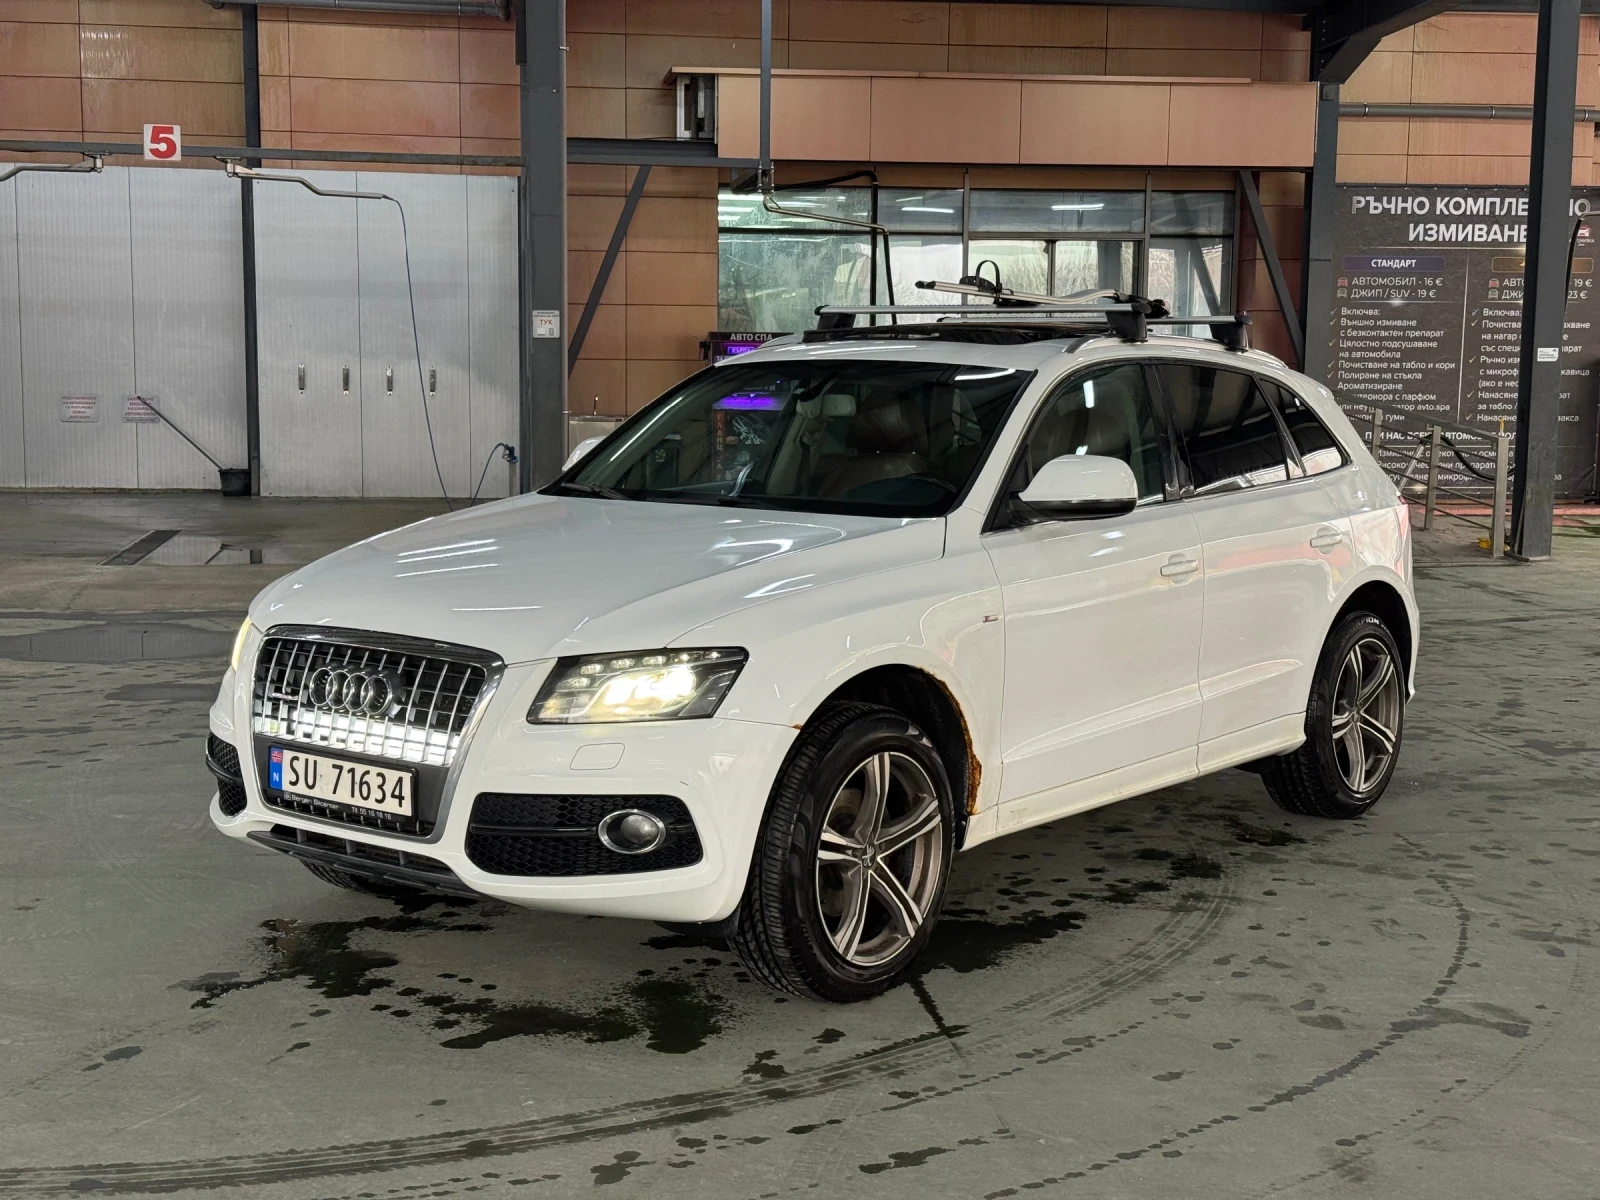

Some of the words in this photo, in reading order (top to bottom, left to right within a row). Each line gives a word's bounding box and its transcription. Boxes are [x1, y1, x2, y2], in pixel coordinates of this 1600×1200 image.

[149, 126, 177, 159] 5
[1352, 196, 1430, 215] РЪЧНО
[1408, 223, 1528, 243] ИЗМИВАНЕ
[1371, 259, 1417, 269] СТАНДАРТ
[1351, 277, 1416, 286] АВТОМОБИЛ
[1424, 277, 1434, 286] 16
[1435, 277, 1443, 286] €
[1573, 279, 1583, 287] 19
[1585, 279, 1593, 287] €
[1350, 289, 1383, 299] ДЖИП
[1390, 289, 1411, 298] SUV
[1417, 289, 1427, 298] 19
[1428, 289, 1437, 298] €
[1580, 290, 1588, 299] €
[1341, 307, 1381, 316] Включва:
[1340, 318, 1375, 326] Външно
[730, 333, 754, 341] АВТО
[754, 333, 773, 341] СПА
[1346, 329, 1403, 337] безконтактен
[1405, 330, 1444, 338] препарат
[1339, 339, 1380, 348] Цялостно
[1381, 341, 1438, 349] подсушаване
[1351, 350, 1401, 358] автомобила
[1480, 356, 1506, 364] Ръчно
[1338, 360, 1388, 369] Почистване
[1402, 361, 1426, 369] табло
[1435, 362, 1455, 371] кори
[1337, 371, 1380, 380] Полиране
[1337, 381, 1403, 391] Ароматизиране
[1478, 379, 1496, 388] (ако
[1401, 392, 1437, 402] парфюм
[1478, 391, 1519, 399] Нанасяне
[1416, 403, 1450, 412] avto.spa
[1385, 414, 1405, 422] гуми
[1476, 414, 1517, 422] Нанасяне
[272, 772, 280, 782] N
[288, 755, 318, 790] SU
[331, 763, 406, 808] 71634
[291, 794, 313, 804] Bergen
